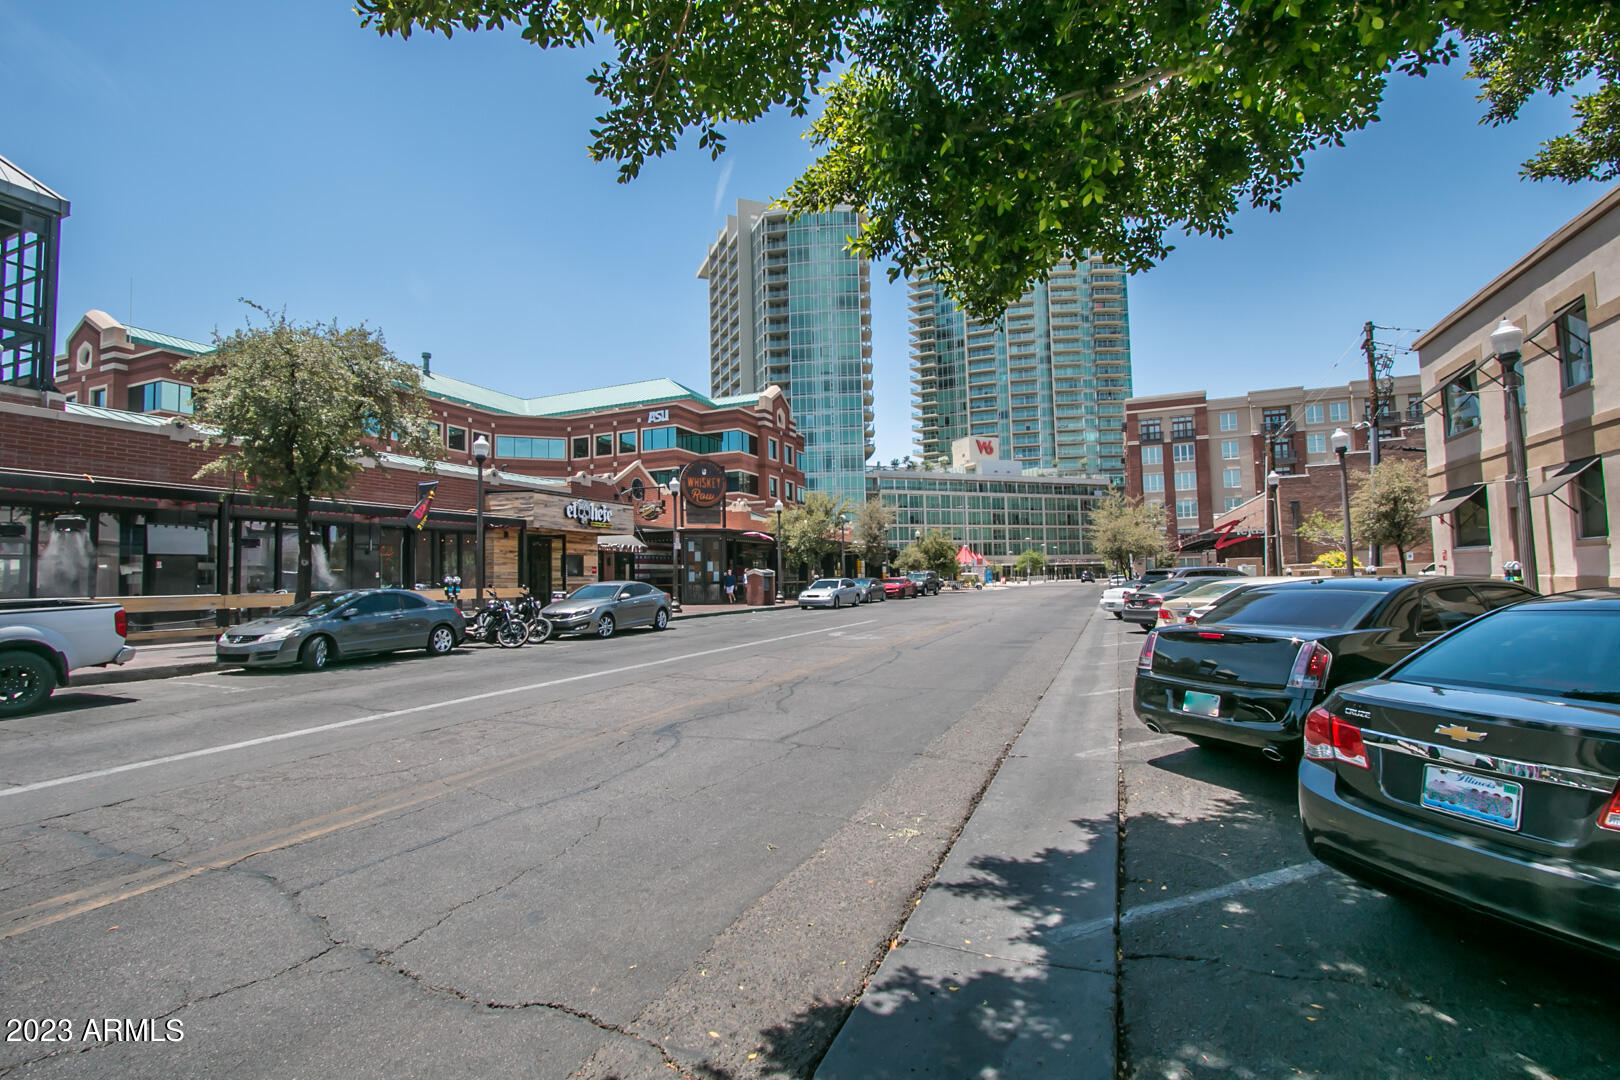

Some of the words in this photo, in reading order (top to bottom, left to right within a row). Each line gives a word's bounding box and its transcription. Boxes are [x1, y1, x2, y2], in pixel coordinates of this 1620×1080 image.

[647, 409, 670, 423] ASU
[687, 477, 721, 488] WHISKEY
[1344, 707, 1371, 719] CRUZE
[1455, 773, 1496, 789] Illinois
